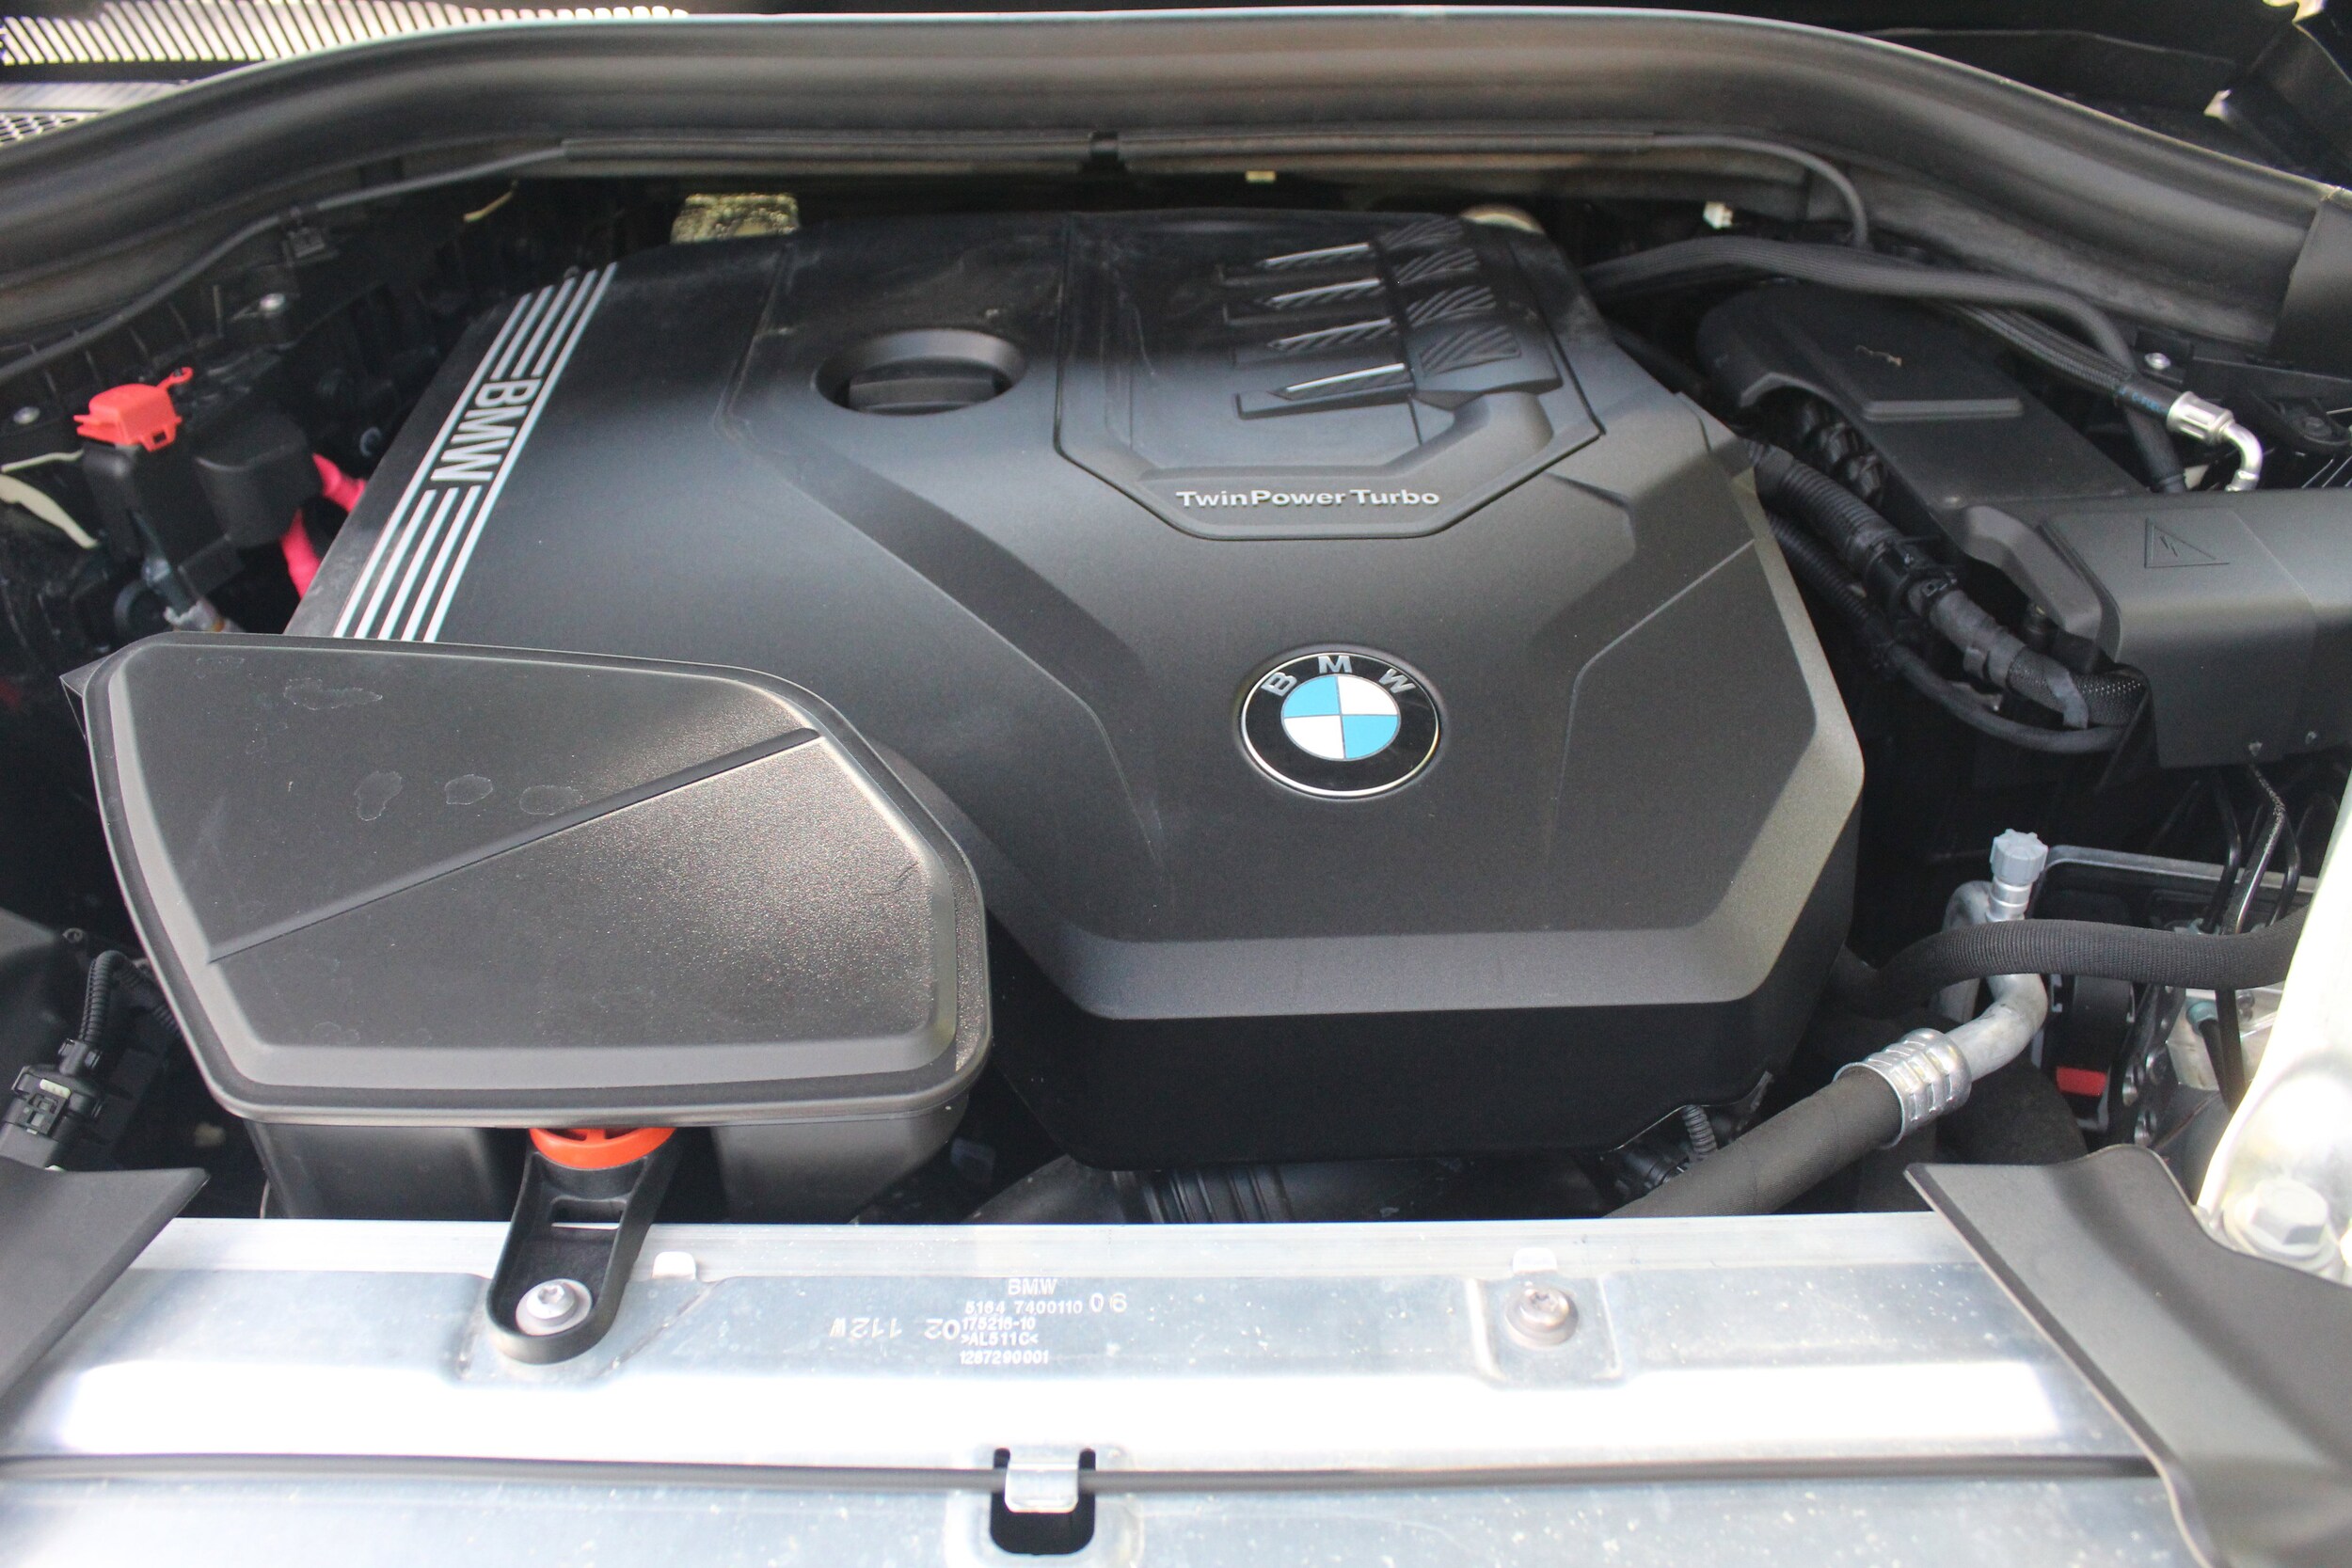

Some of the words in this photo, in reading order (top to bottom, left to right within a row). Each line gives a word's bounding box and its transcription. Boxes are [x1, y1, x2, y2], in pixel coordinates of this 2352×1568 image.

[429, 379, 542, 483] BMW
[1349, 489, 1440, 506] Turbo
[1261, 655, 1416, 697] BMW
[1008, 1278, 1058, 1295] BMW
